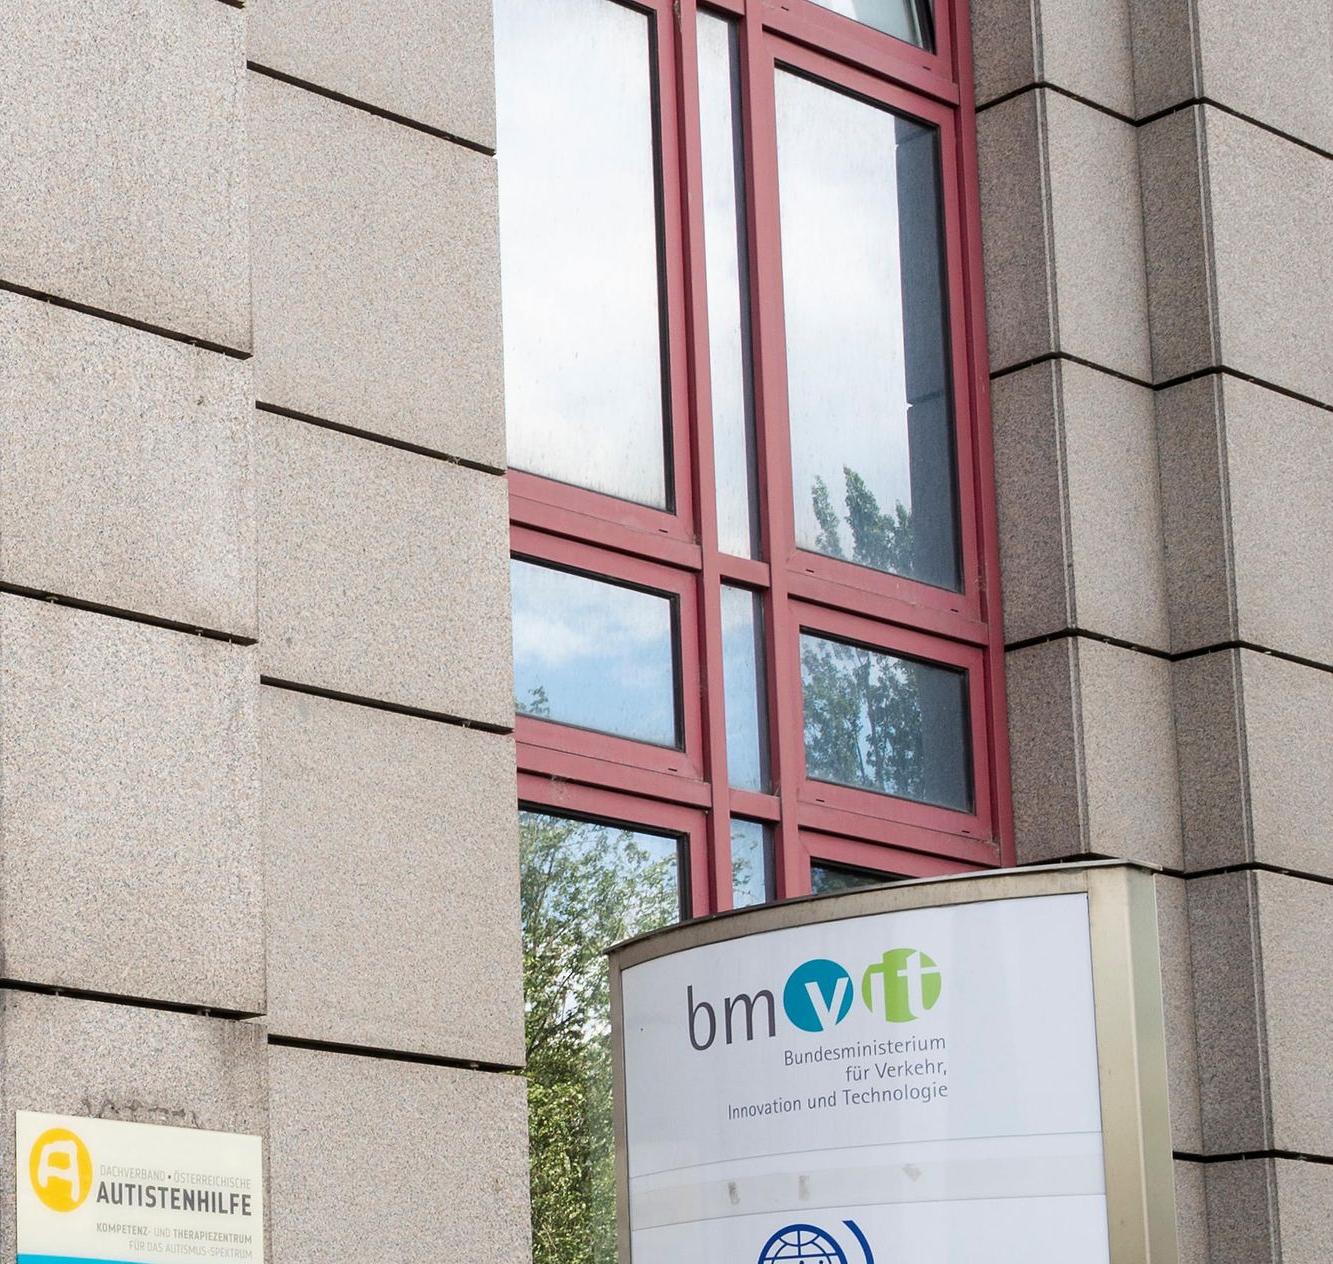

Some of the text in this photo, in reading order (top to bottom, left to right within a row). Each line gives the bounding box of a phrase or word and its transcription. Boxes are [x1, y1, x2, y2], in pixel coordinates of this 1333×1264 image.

[784, 1036, 946, 1066] Bundesministerium
[845, 1060, 947, 1082] für Verkehr,
[728, 1083, 949, 1120] Innovation und Technologie
[100, 1165, 252, 1189] DACHVERBAND ÖSTERREICHISCHE
[96, 1181, 252, 1216] AUTISTENHILFE
[96, 1223, 252, 1244] KOMPETENZ- UND THERAPIEZENTRUM
[129, 1240, 146, 1251] FÜR
[147, 1242, 164, 1252] DAS
